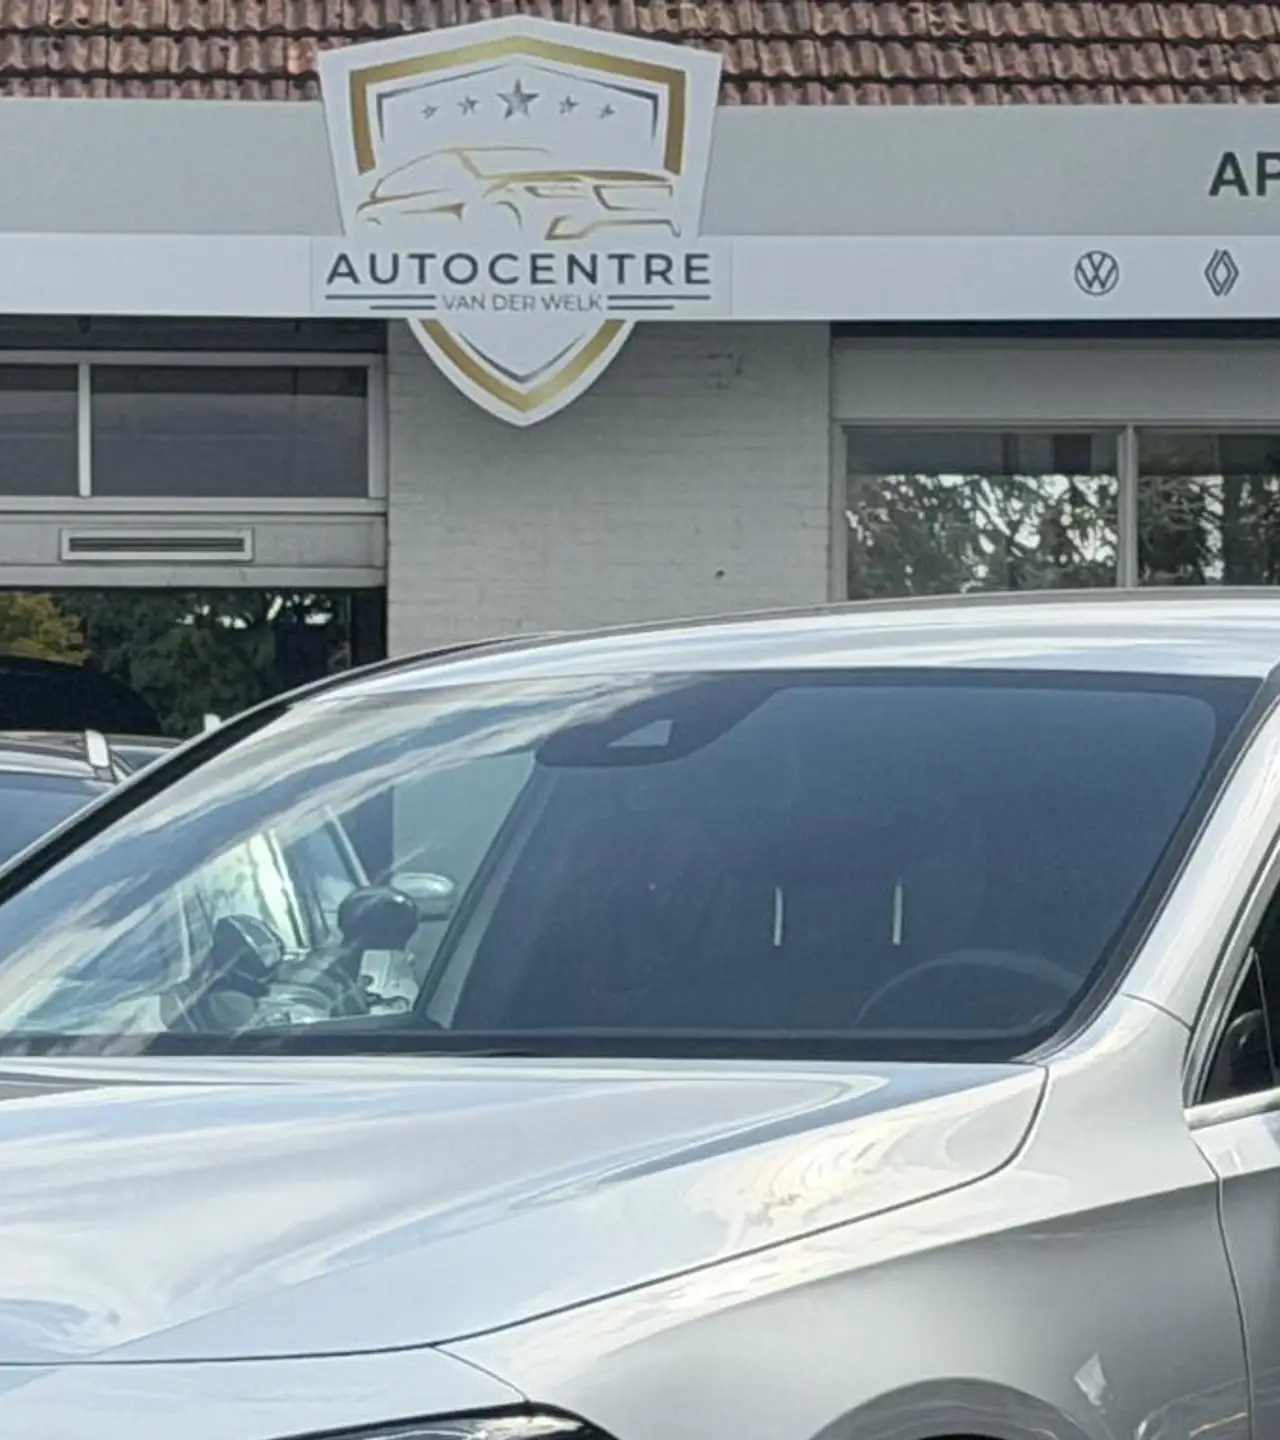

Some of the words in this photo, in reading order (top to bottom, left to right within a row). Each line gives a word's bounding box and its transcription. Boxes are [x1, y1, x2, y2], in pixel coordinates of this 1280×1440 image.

[326, 252, 711, 285] AUTOCENTRE
[442, 294, 486, 311] VAN
[492, 294, 536, 312] DER
[540, 294, 602, 312] WELK
